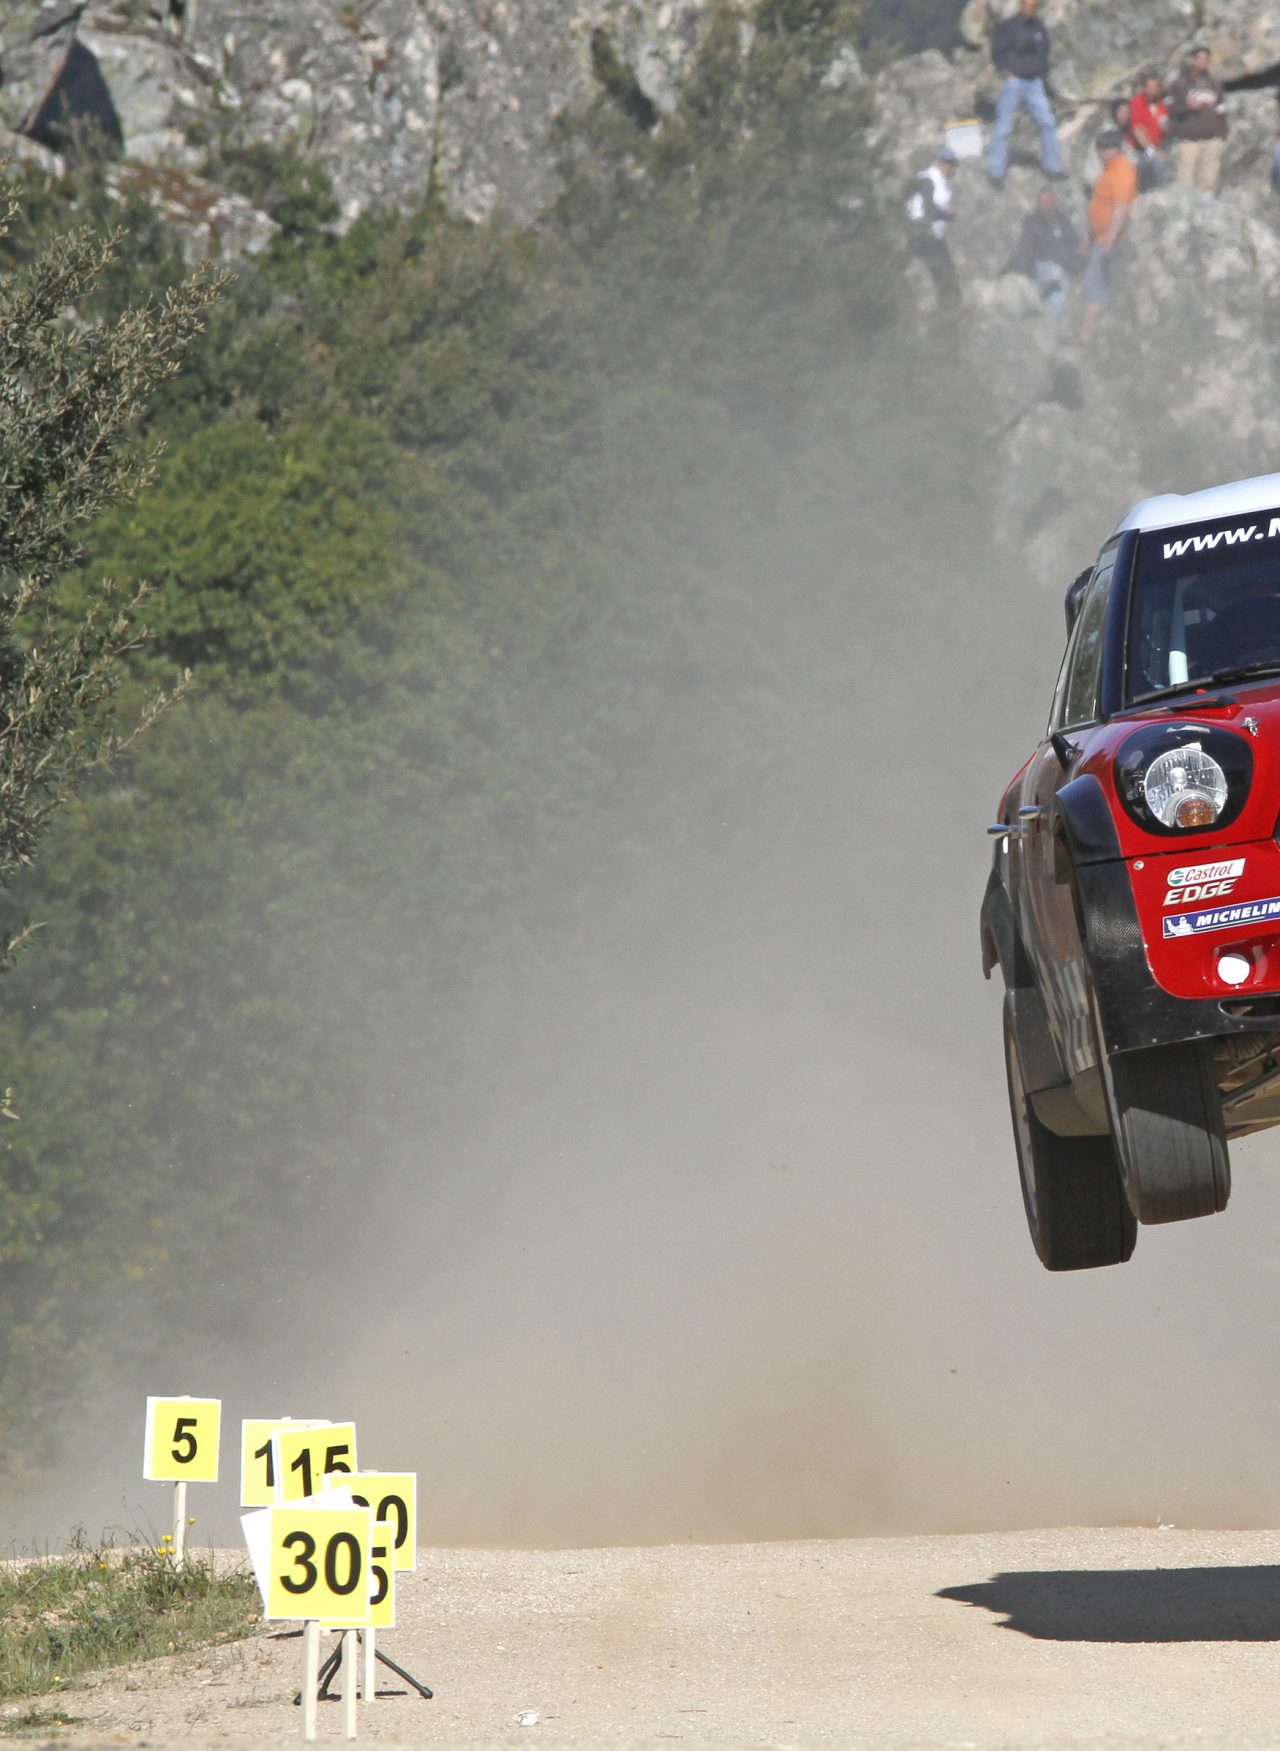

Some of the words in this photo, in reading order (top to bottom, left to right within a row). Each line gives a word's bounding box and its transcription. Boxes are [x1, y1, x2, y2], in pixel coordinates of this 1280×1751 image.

[1163, 878, 1238, 906] EDGE
[1184, 863, 1234, 882] Castrol
[171, 1418, 198, 1464] 5
[254, 1439, 275, 1487] 1
[279, 1531, 362, 1595] 30
